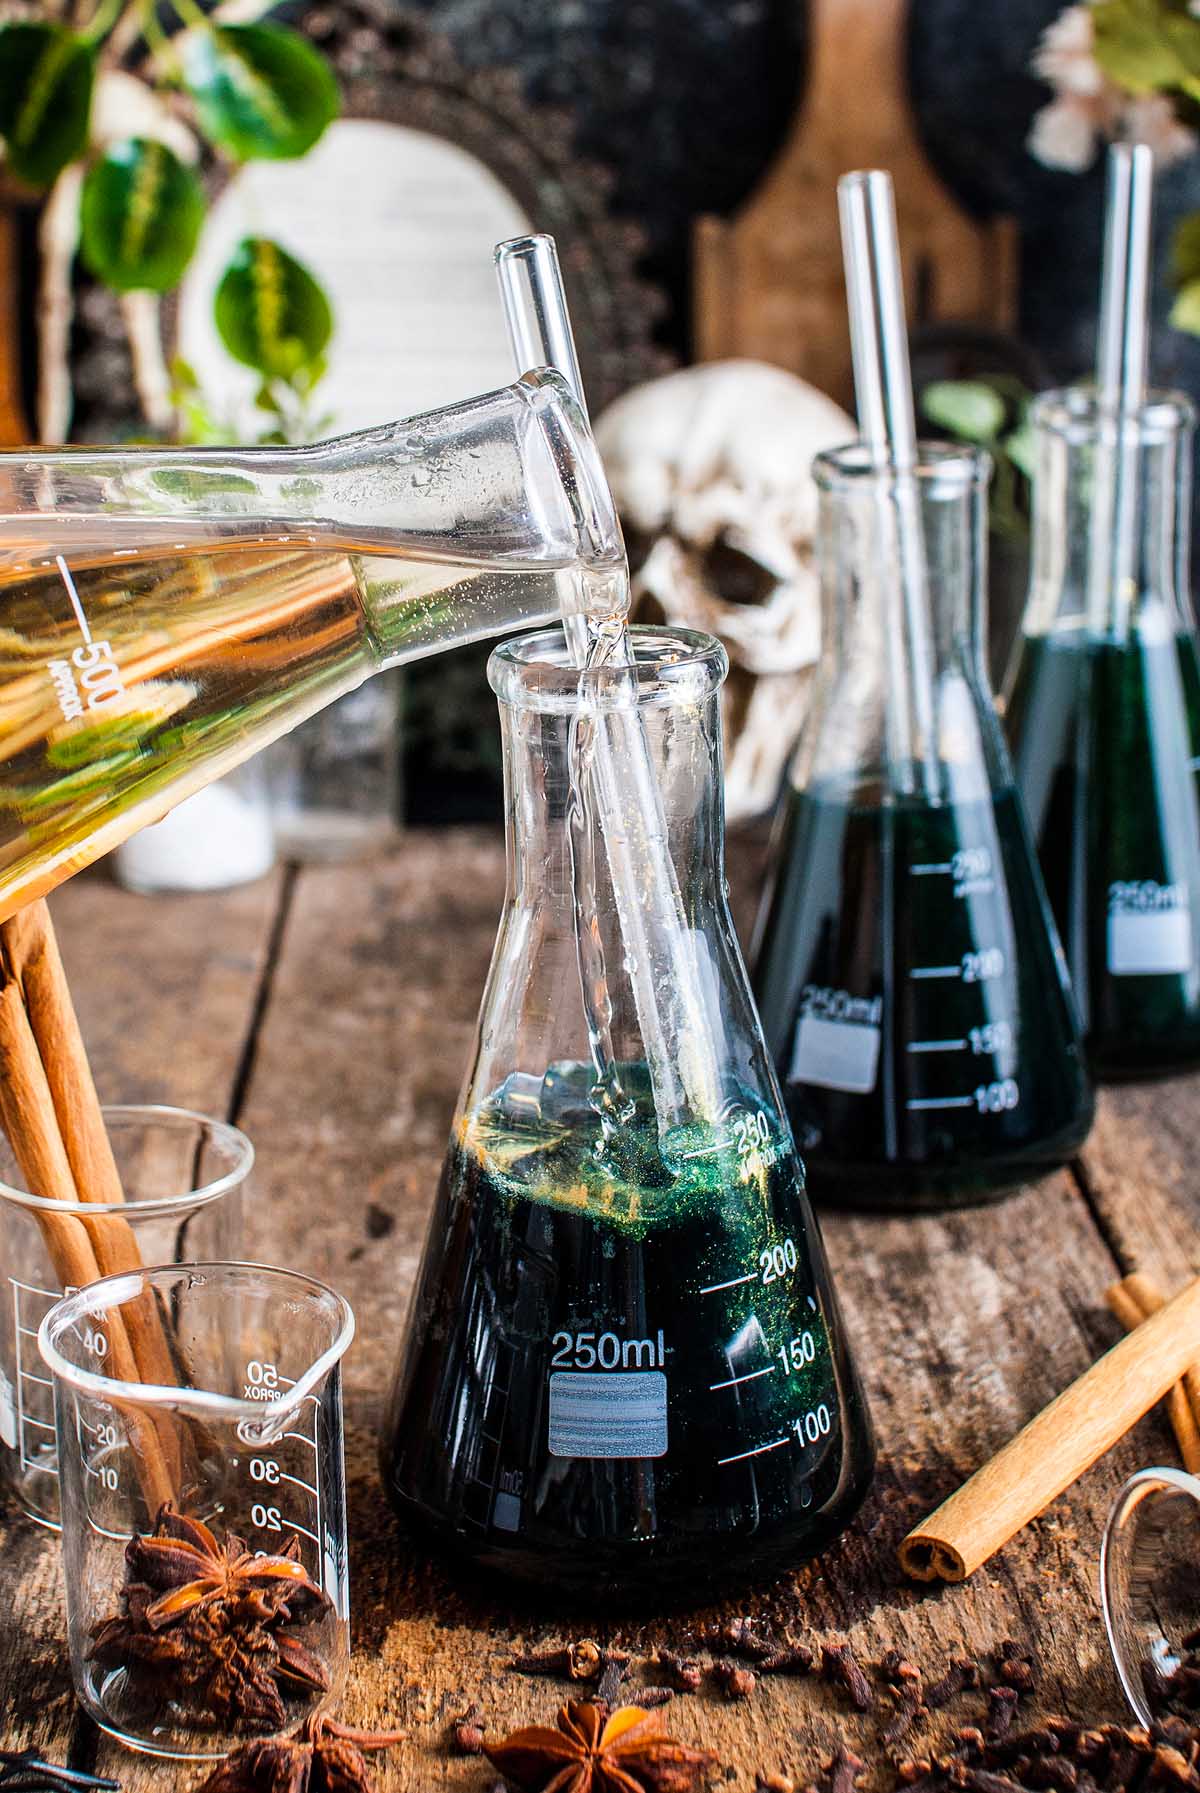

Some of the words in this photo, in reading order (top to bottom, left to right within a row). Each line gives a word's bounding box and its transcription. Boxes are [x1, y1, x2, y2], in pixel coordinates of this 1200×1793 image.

[72, 640, 127, 709] 500
[975, 1078, 1019, 1113] 100
[733, 1110, 769, 1153] 250
[760, 1238, 797, 1284] 200
[83, 1327, 107, 1357] 40
[551, 1329, 665, 1369] 250ml
[777, 1331, 815, 1375] 150
[97, 1424, 115, 1449] 20
[793, 1404, 830, 1447] 100
[100, 1466, 117, 1491] 10
